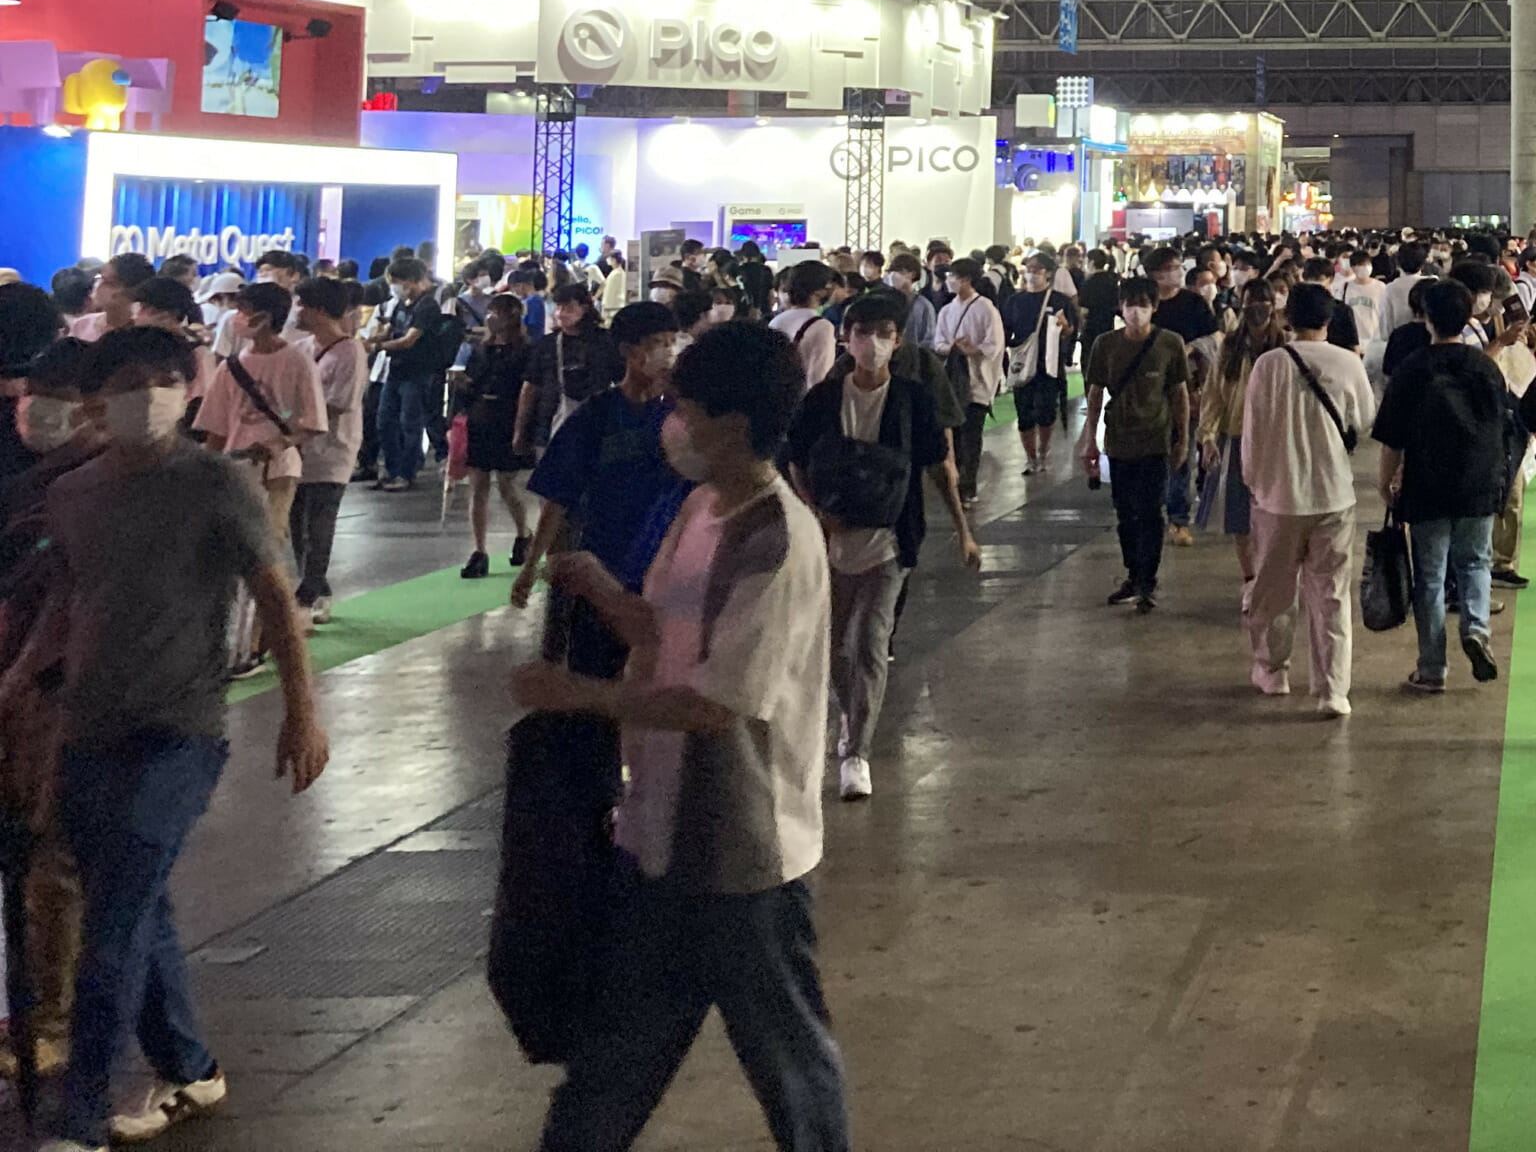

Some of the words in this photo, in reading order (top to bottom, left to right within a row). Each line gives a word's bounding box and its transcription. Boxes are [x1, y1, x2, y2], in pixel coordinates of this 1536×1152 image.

[649, 17, 778, 63] PICO
[887, 145, 980, 173] PICO
[729, 206, 762, 216] Game
[147, 225, 219, 265] Meta
[220, 224, 296, 268] Quest
